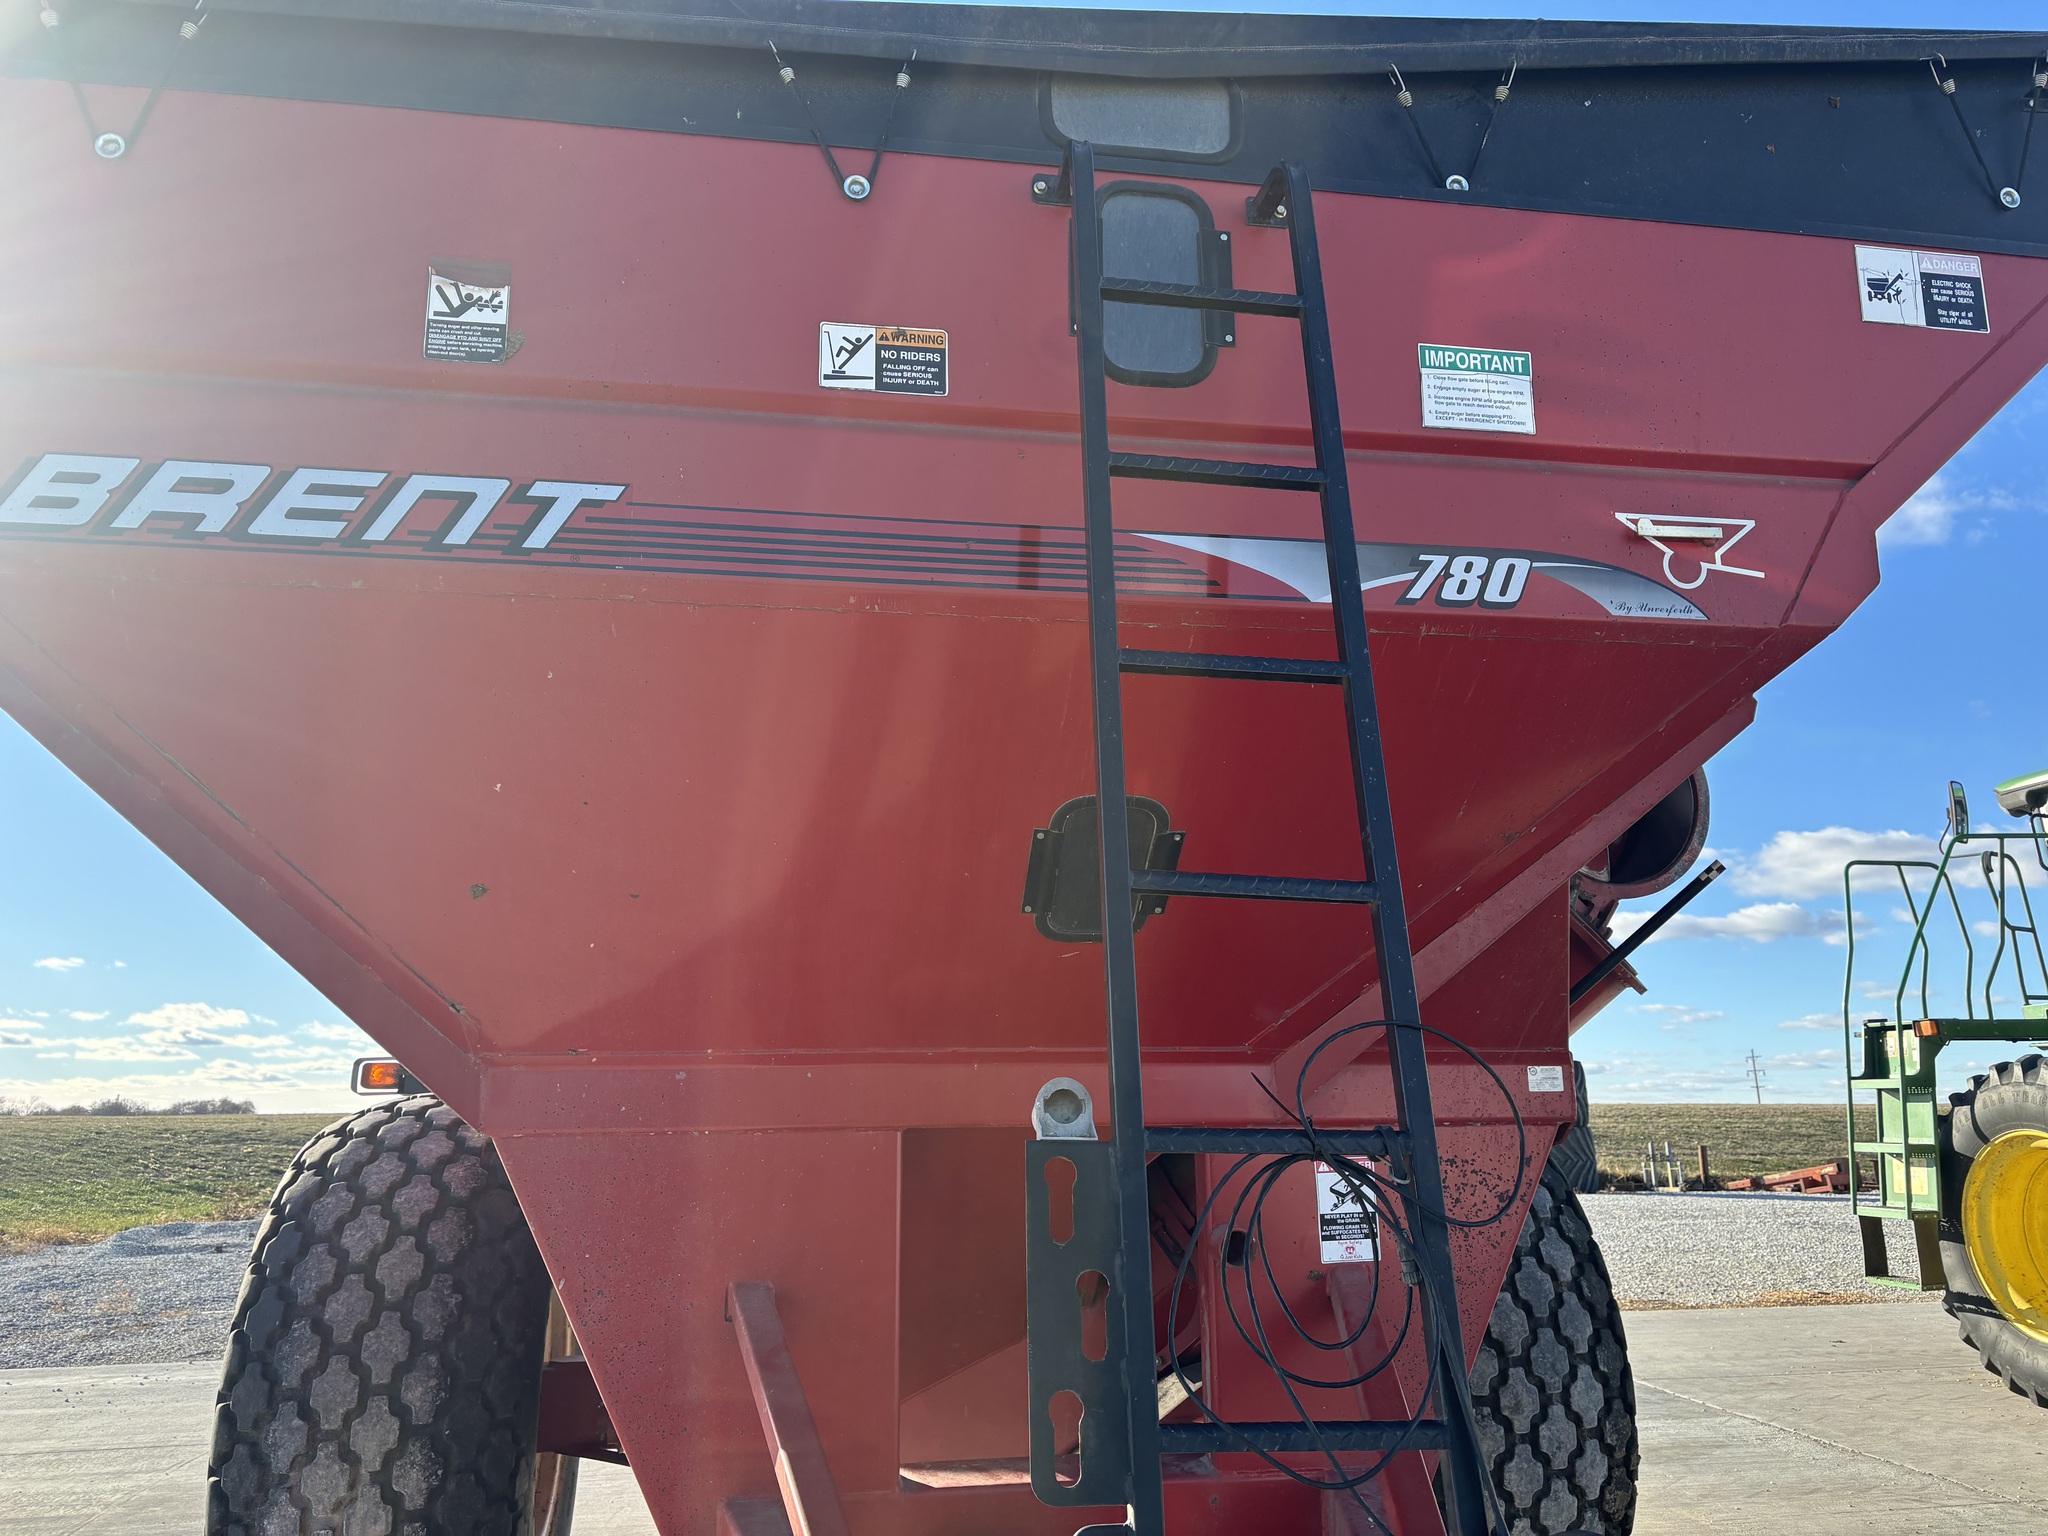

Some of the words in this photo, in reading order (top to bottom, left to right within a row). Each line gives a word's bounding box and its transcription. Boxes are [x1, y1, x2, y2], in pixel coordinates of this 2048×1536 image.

[1933, 260, 1978, 272] DANGER
[891, 330, 944, 345] WARNING
[881, 350, 897, 359] NO
[901, 351, 940, 362] RIDERS
[1425, 350, 1525, 373] IMPORTANT
[0, 453, 627, 550] BRENT
[1398, 554, 1531, 607] 780
[1615, 602, 1634, 614] By
[1982, 1092, 2004, 1109] ALL
